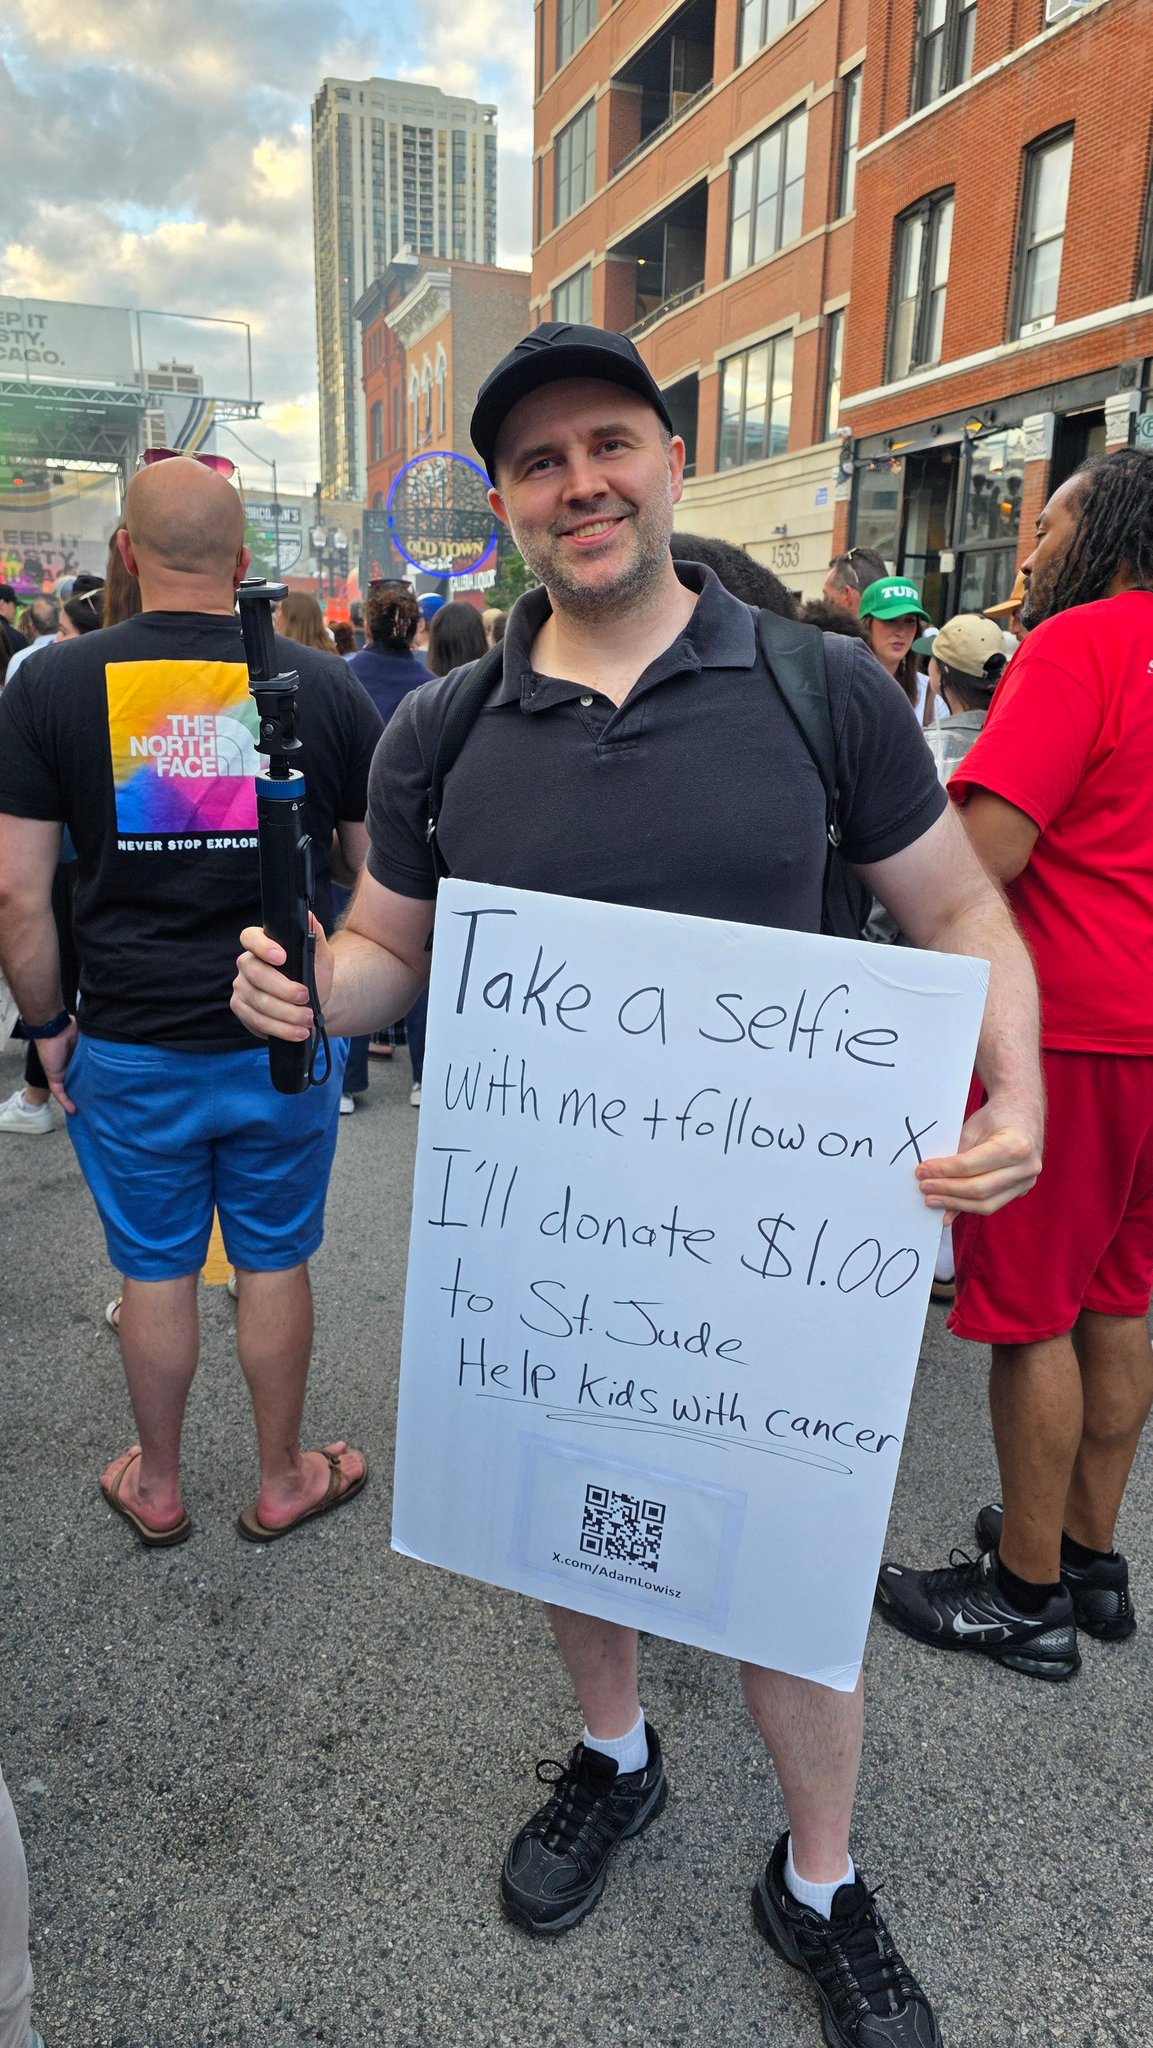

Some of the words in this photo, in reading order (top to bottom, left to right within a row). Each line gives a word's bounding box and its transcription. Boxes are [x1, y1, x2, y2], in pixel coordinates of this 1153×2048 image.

[27, 313, 48, 329] IT
[0, 529, 53, 546] EEP
[406, 540, 437, 558] OLD
[440, 541, 485, 558] TOWN
[772, 542, 800, 569] 1553
[166, 714, 216, 736] THE
[130, 735, 216, 757] NORTH
[156, 756, 218, 778] FACE
[117, 839, 163, 851] NEVER
[167, 839, 202, 850] STOP
[451, 909, 591, 1032] Take
[618, 986, 666, 1046] a
[559, 1088, 627, 1137] me
[817, 1131, 873, 1158] on
[889, 1115, 939, 1168] X
[428, 1146, 519, 1229] I'll
[540, 1184, 716, 1265] donate
[740, 1211, 920, 1299] $1.00
[439, 1257, 495, 1319] to
[519, 1279, 594, 1338] St.
[605, 1299, 749, 1366] Jude
[458, 1337, 557, 1400] Help
[672, 1391, 748, 1433] with
[764, 1409, 900, 1455] cancer
[551, 1550, 682, 1600] X.com/AdamLowisz
